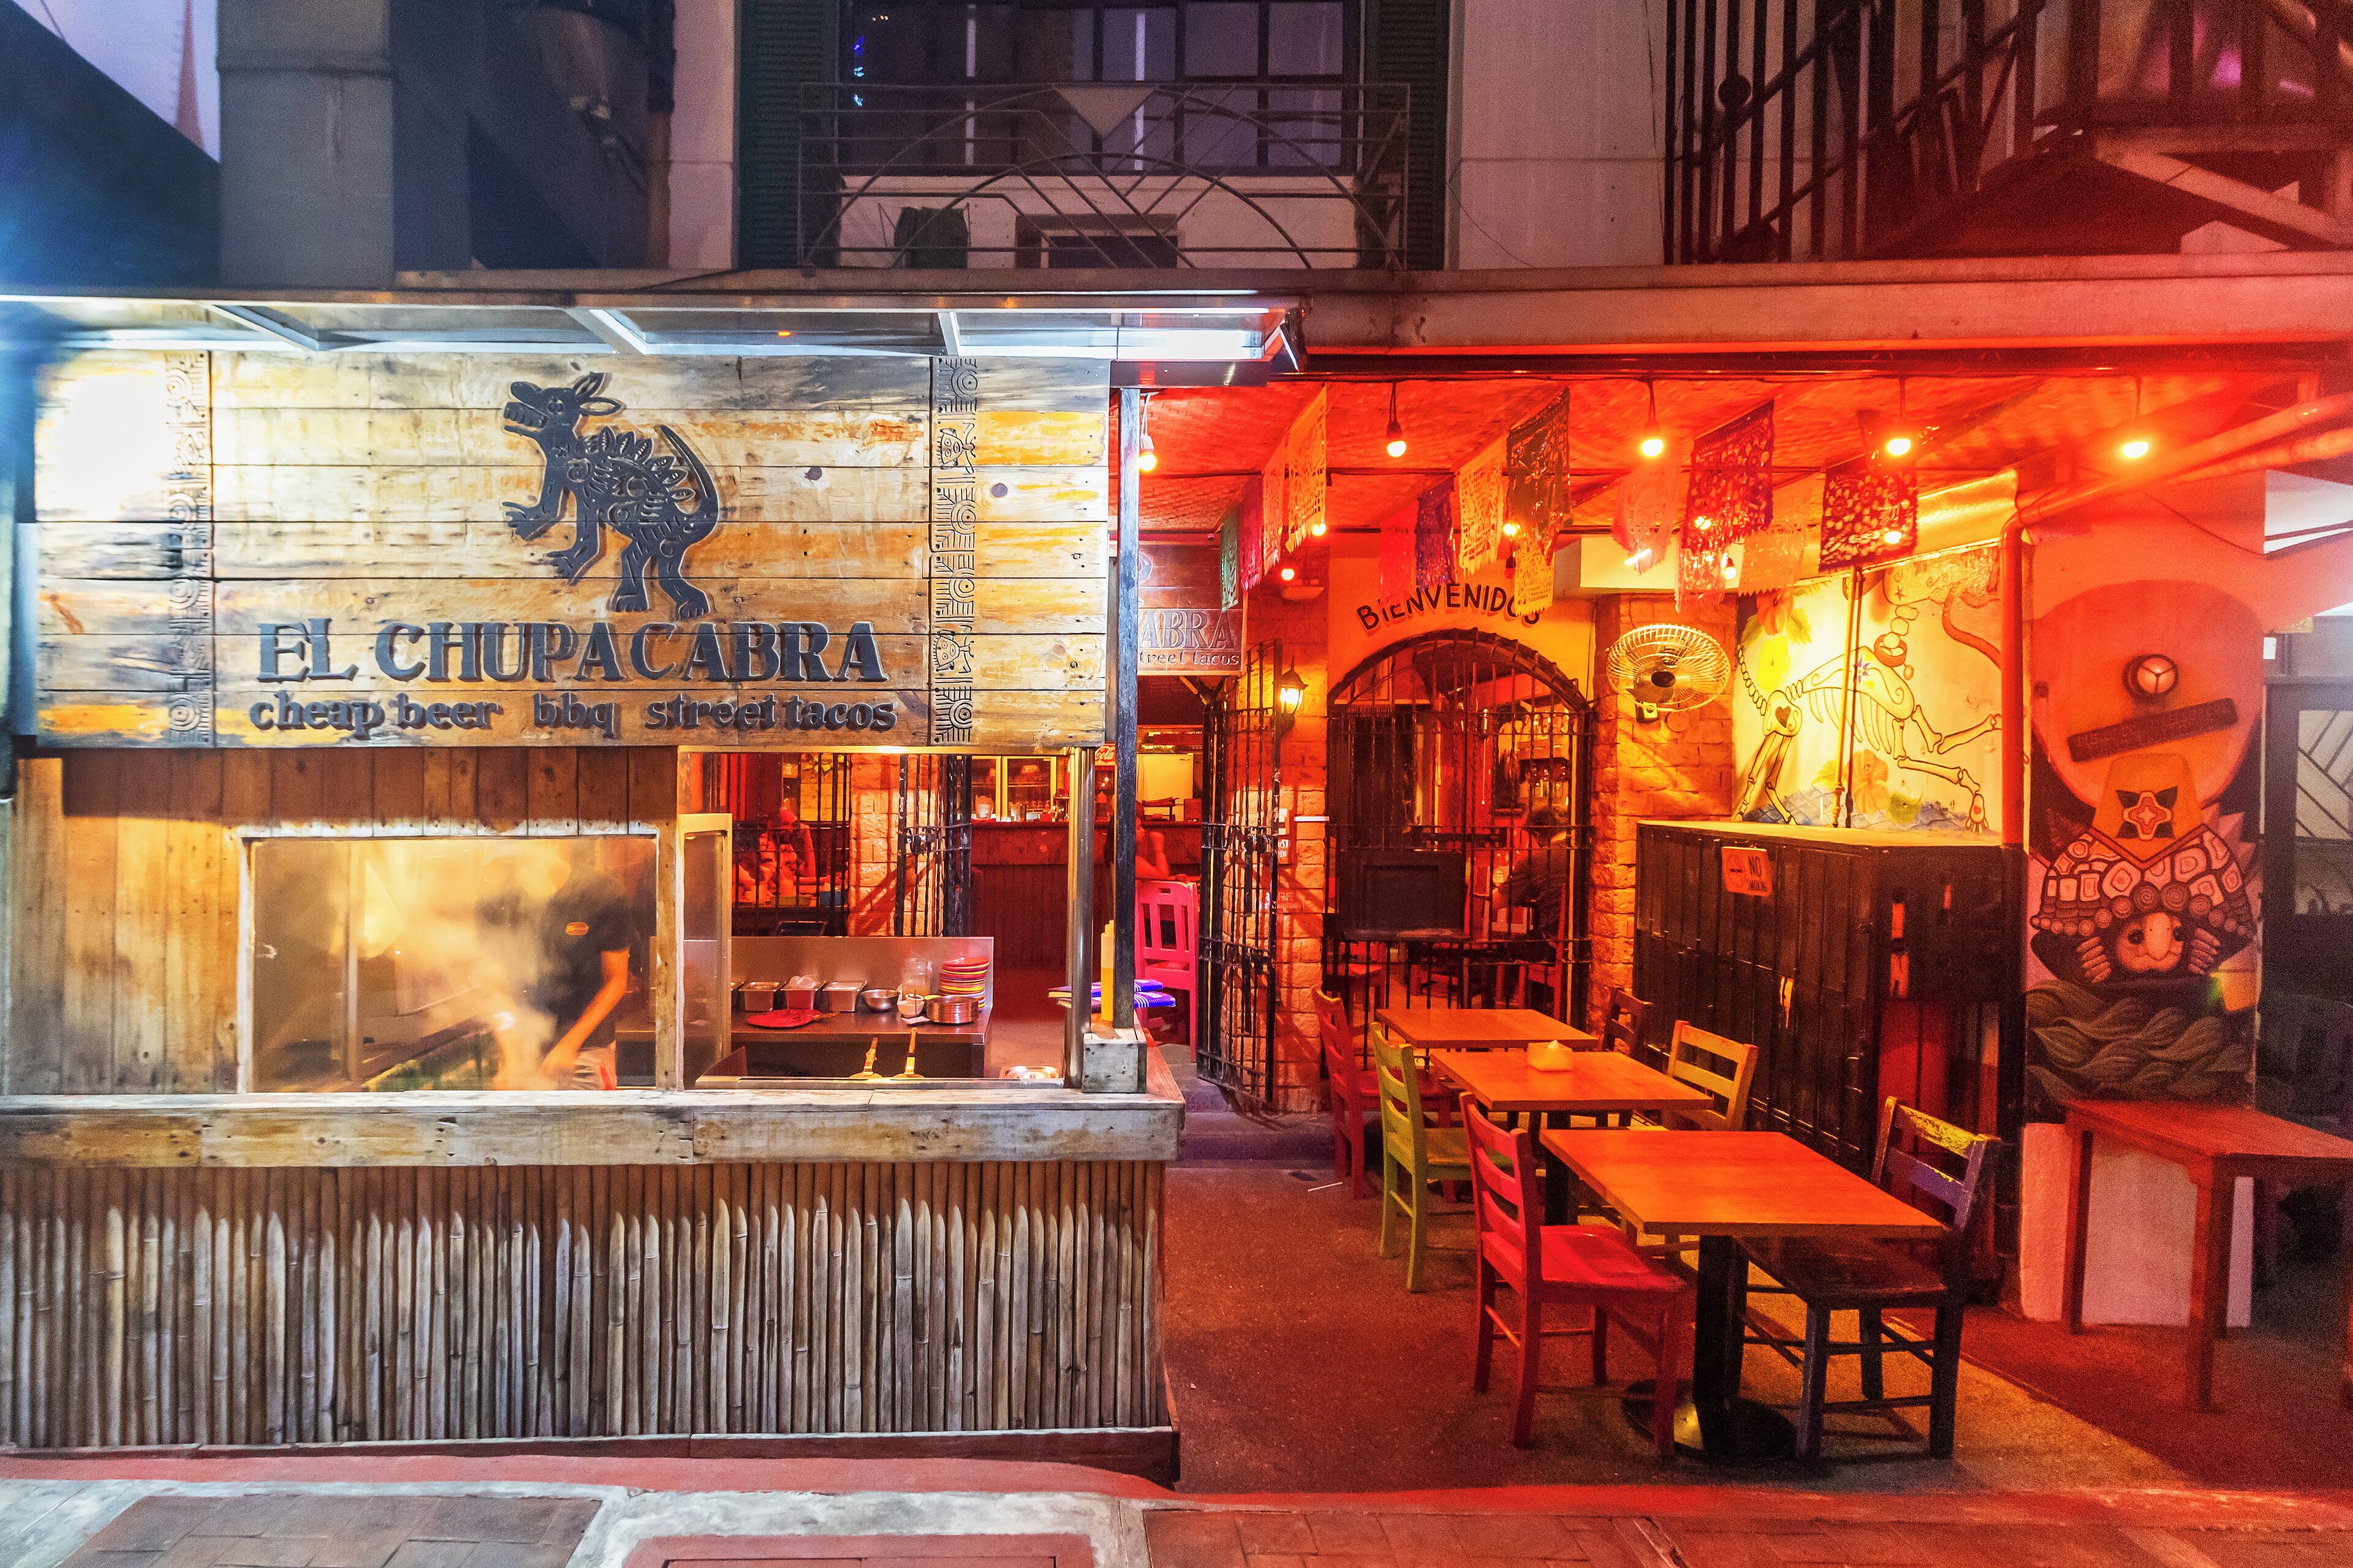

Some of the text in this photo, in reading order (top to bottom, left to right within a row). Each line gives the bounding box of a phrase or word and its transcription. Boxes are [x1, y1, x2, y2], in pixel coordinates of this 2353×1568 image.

[257, 617, 889, 683] EL CHUPACABRA
[1139, 611, 1235, 648] ABRA
[1139, 651, 1240, 666] treet tacos
[249, 690, 898, 740] cheap beer bbq street tacos
